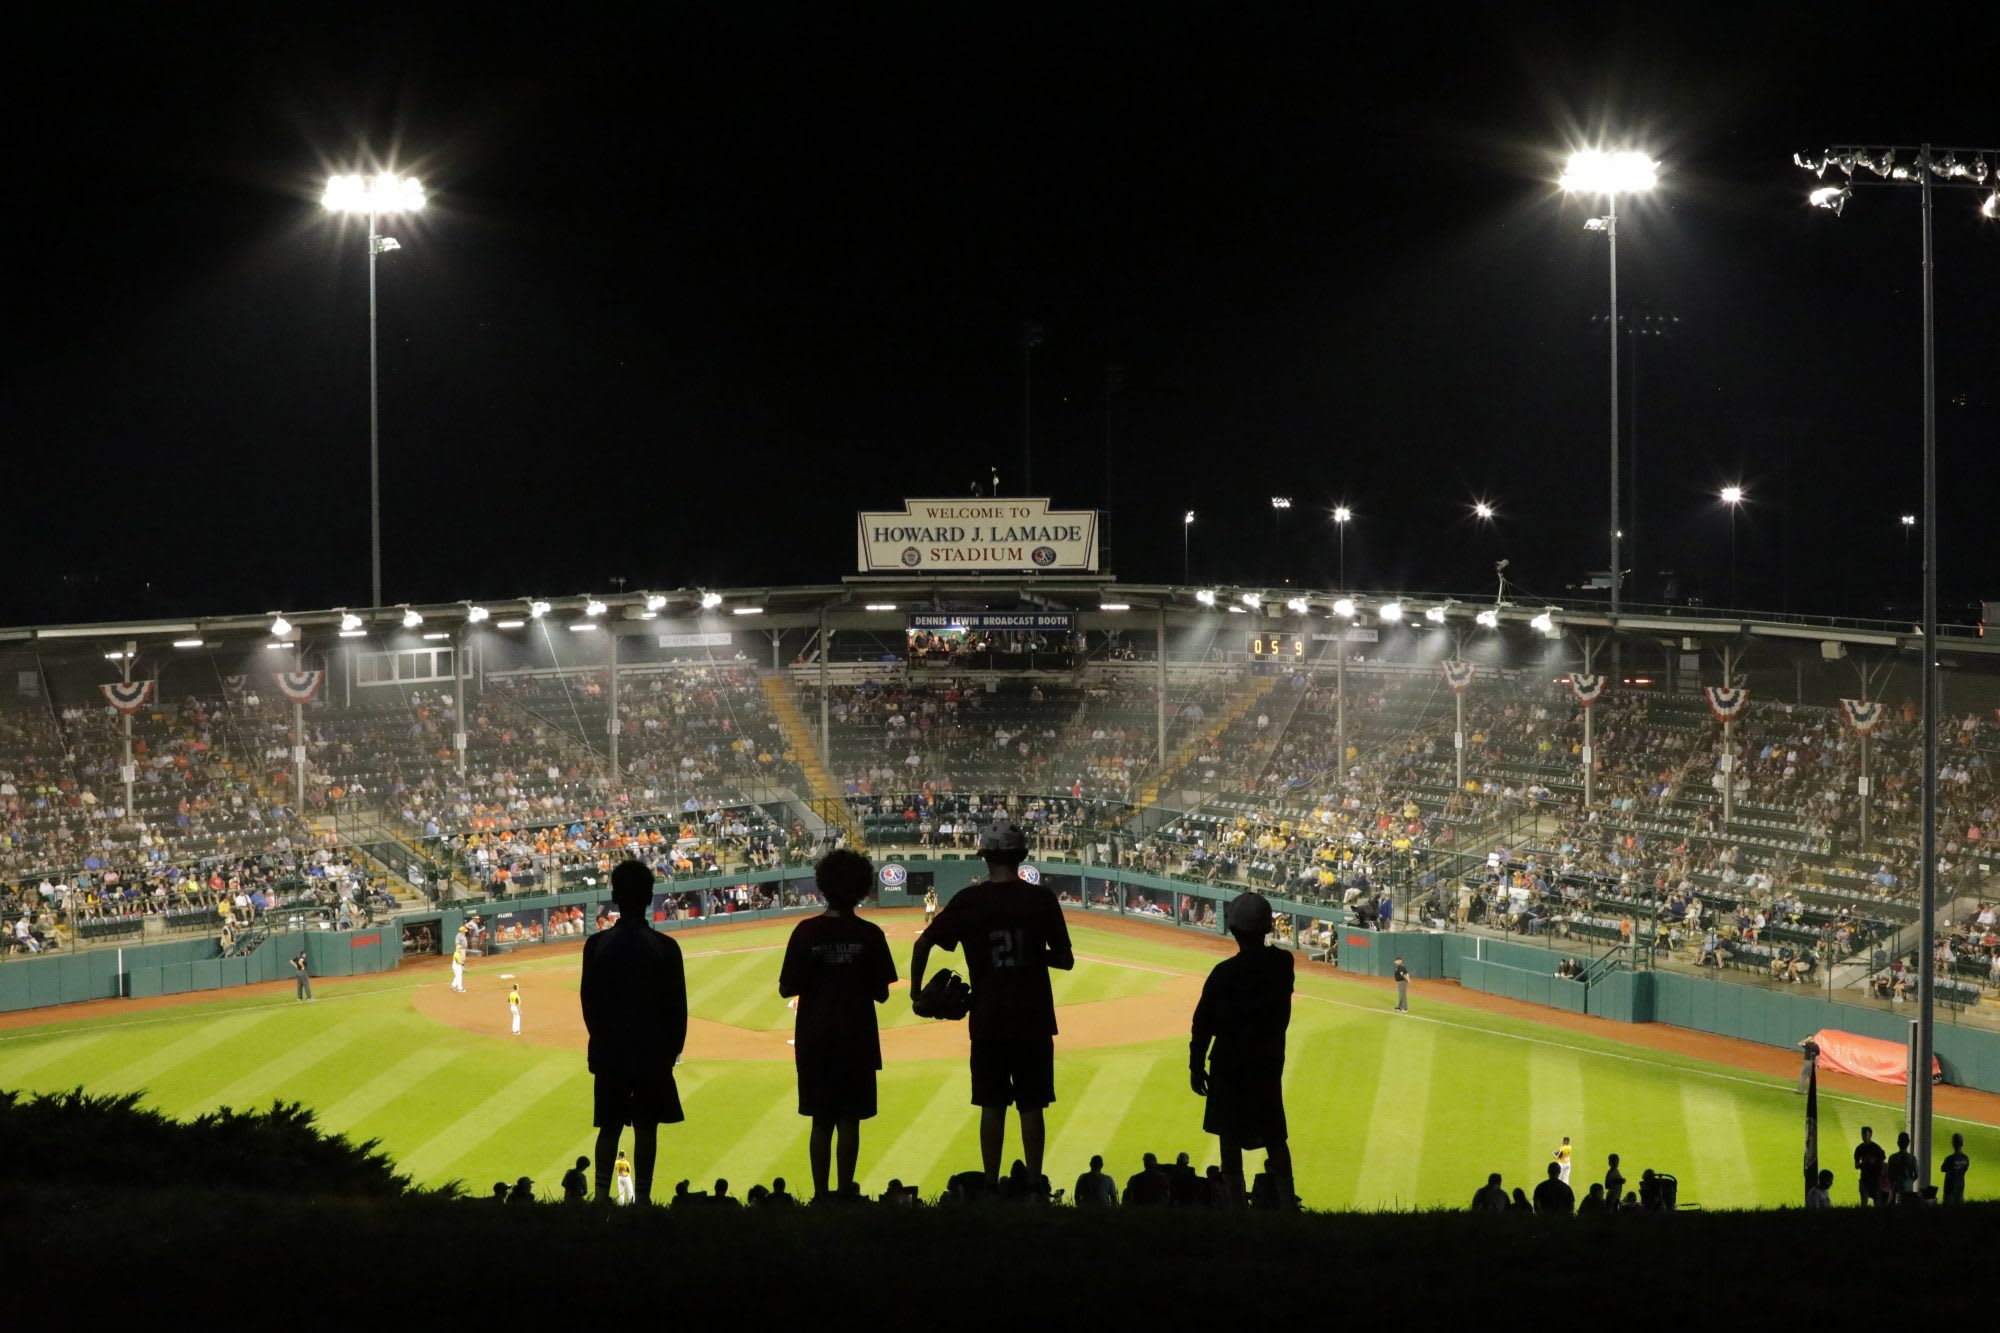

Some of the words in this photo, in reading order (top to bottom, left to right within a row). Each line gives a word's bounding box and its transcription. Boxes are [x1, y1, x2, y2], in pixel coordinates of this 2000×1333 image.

[926, 507, 1003, 519] WELCOME
[1009, 507, 1030, 518] TO
[873, 526, 965, 543] HOWARD
[971, 526, 984, 542] J.
[991, 525, 1082, 542] LAMADE
[930, 547, 1023, 562] STADIUM
[915, 616, 948, 625] DENNIS
[951, 616, 979, 625] LEWIN
[983, 616, 1034, 625] BROADCAST
[1038, 616, 1068, 625] BOOTH
[1254, 639, 1262, 654] 0
[1271, 640, 1279, 655] 5
[1294, 641, 1303, 656] 9
[988, 928, 1025, 968] 21
